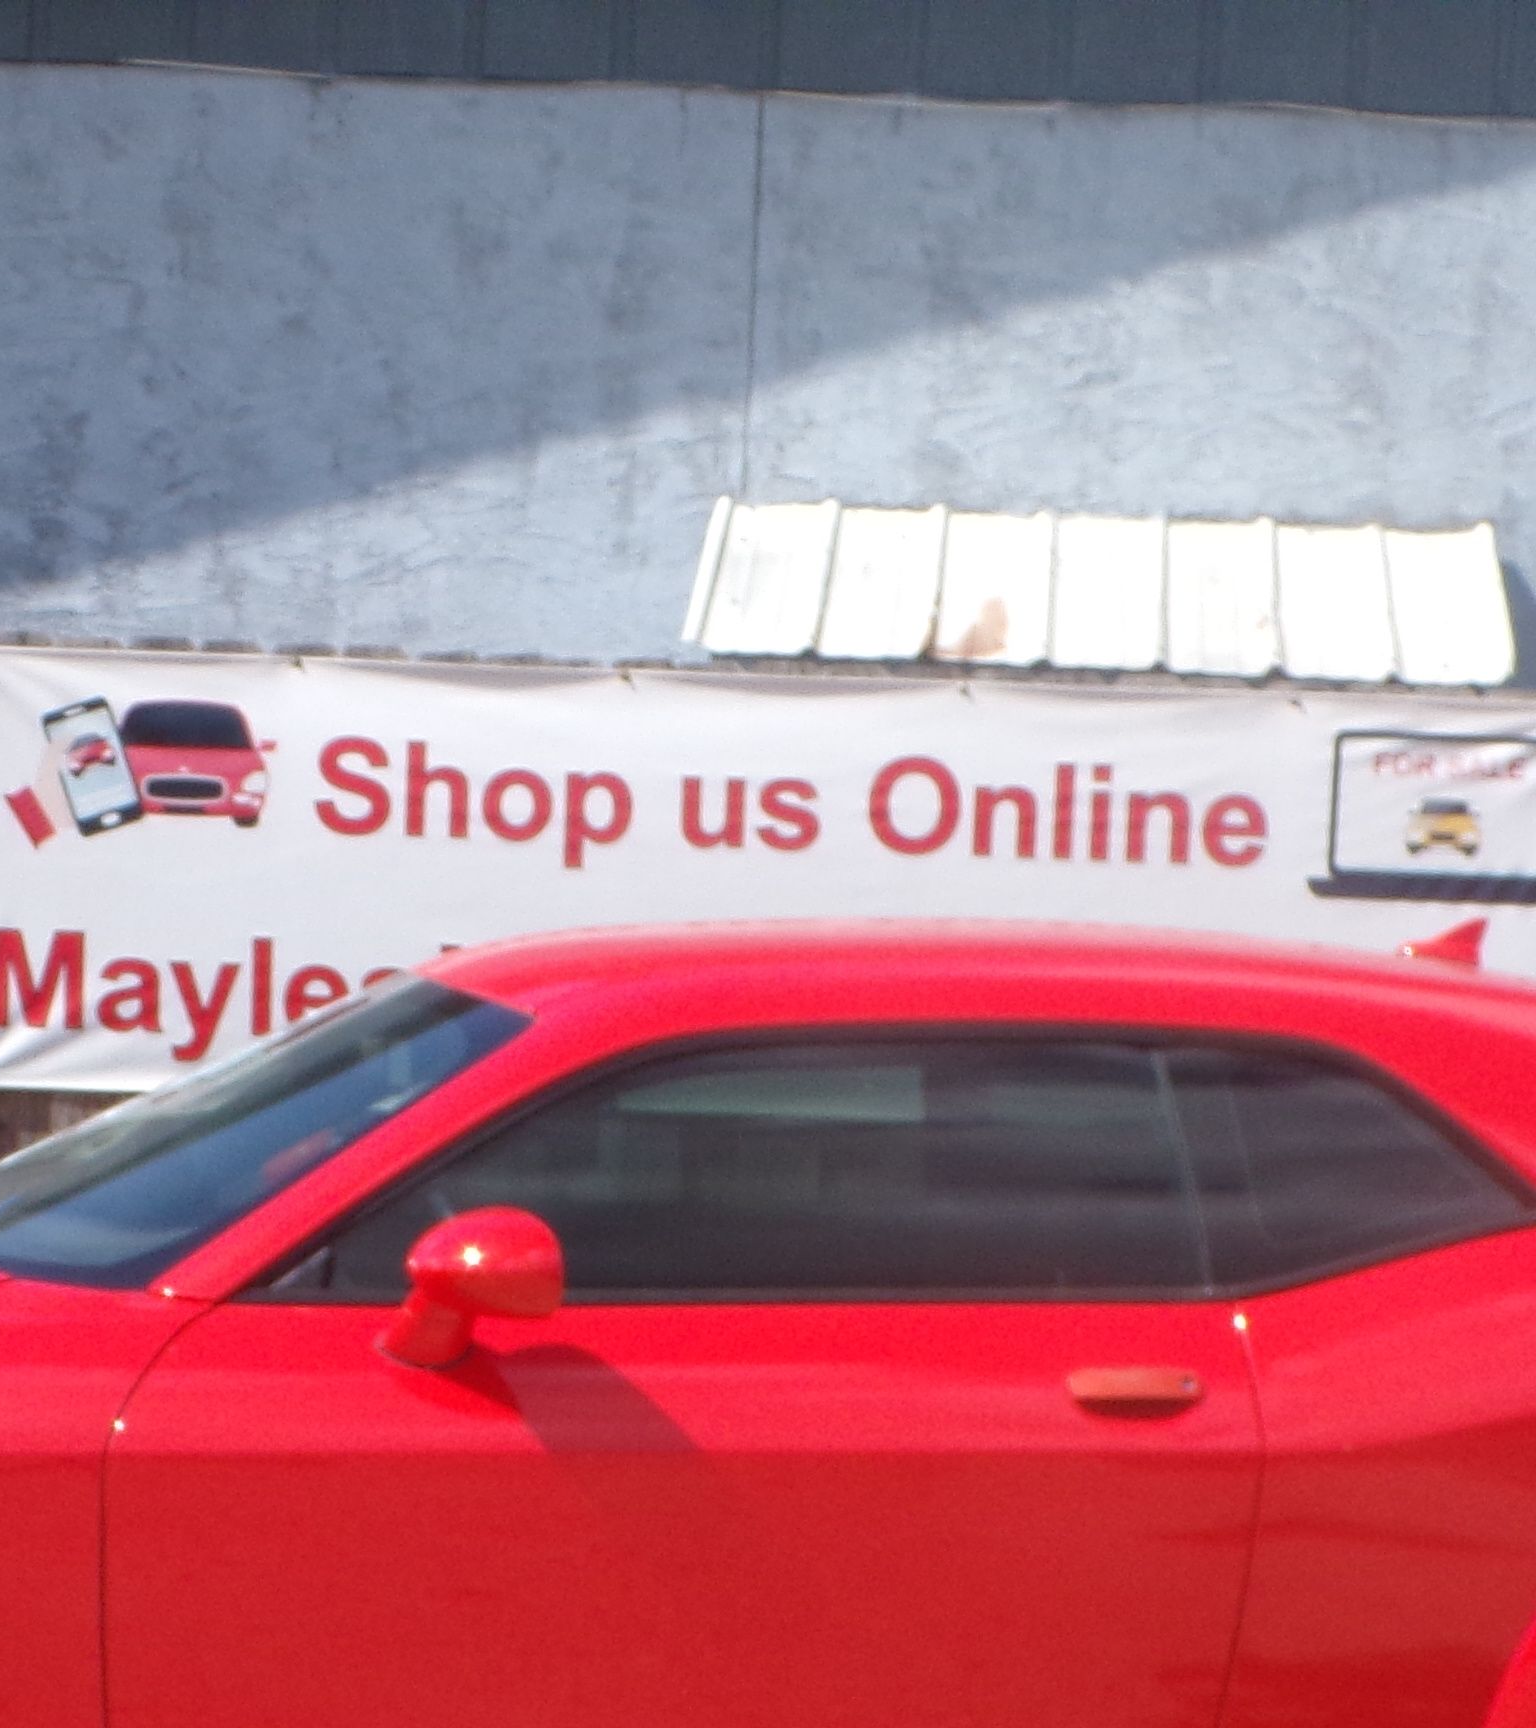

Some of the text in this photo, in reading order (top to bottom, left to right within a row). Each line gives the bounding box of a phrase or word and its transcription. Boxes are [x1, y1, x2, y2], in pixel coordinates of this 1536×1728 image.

[314, 736, 1269, 869] Shop us Online
